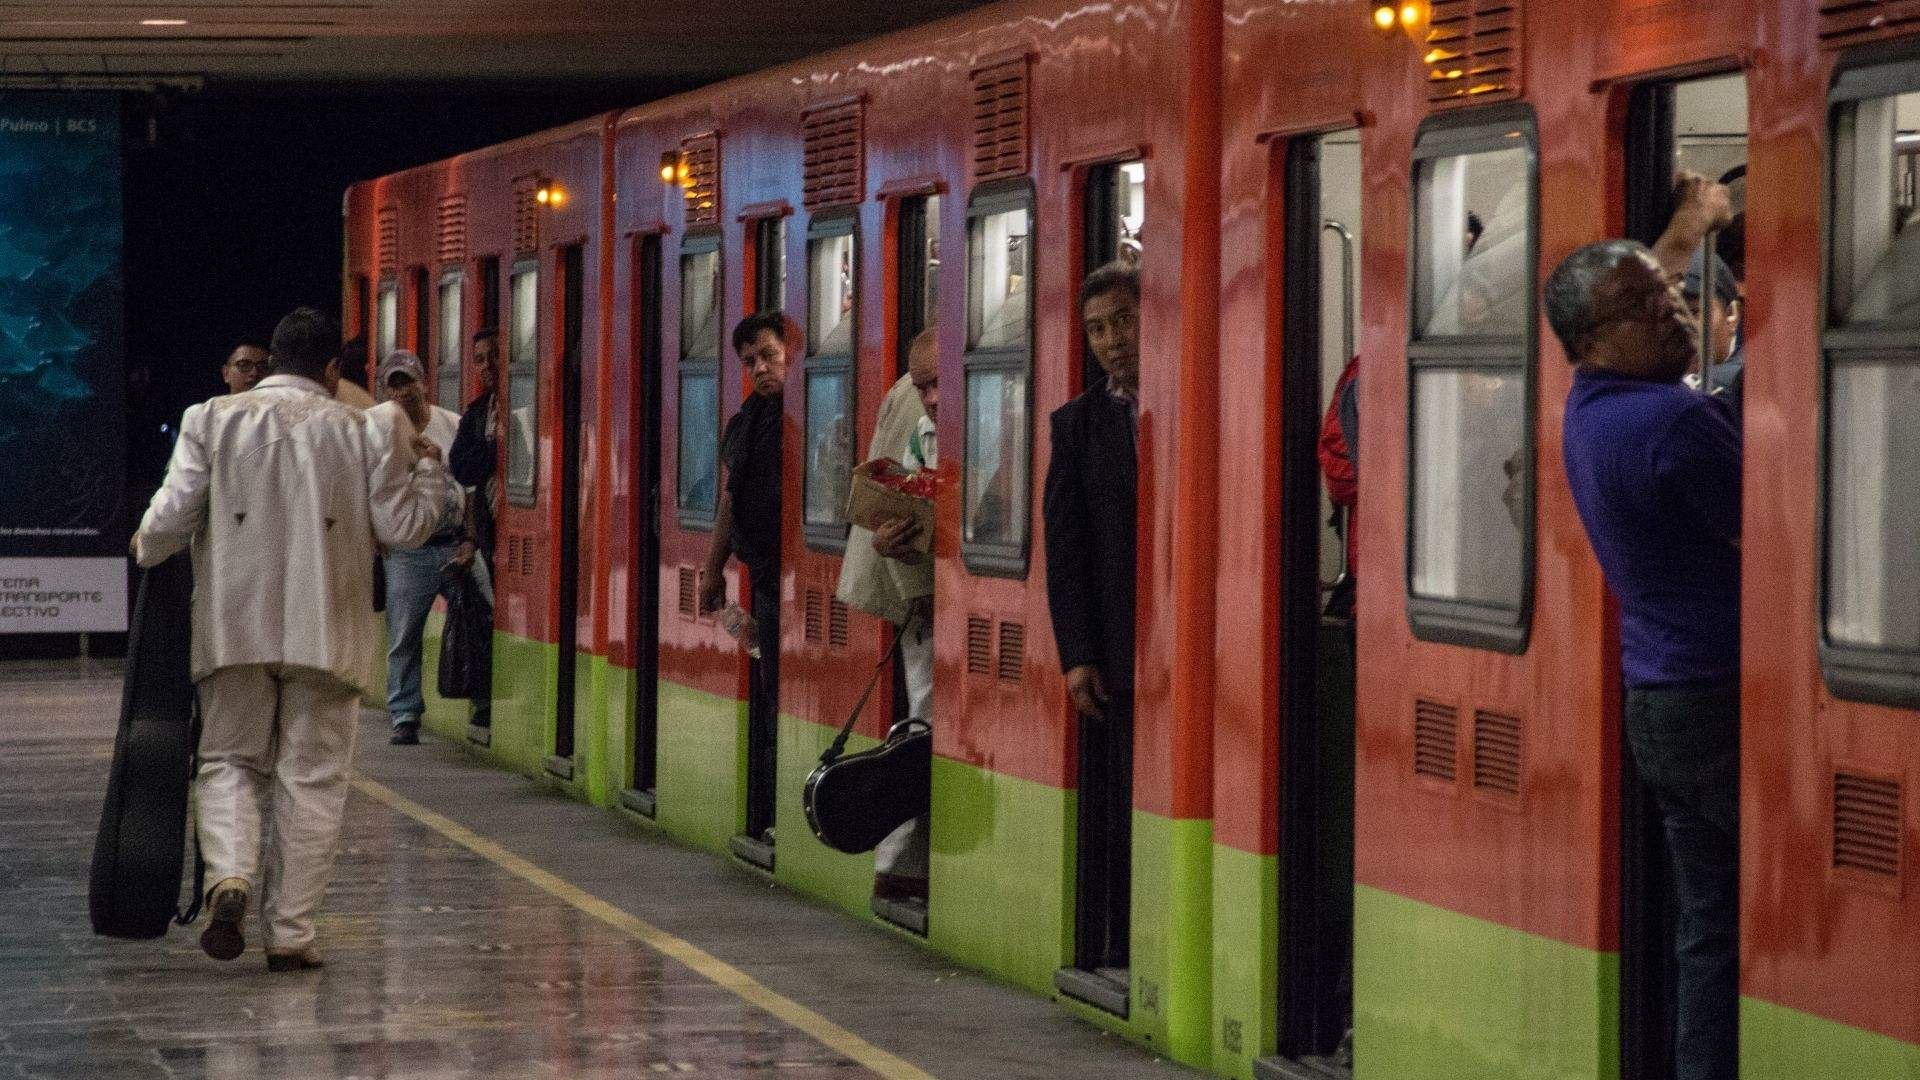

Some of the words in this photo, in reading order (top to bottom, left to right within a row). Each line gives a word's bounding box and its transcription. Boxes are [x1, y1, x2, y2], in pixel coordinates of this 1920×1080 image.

[0, 117, 48, 132] Pulmo
[67, 118, 96, 132] BCS
[0, 606, 59, 617] ECTIVO
